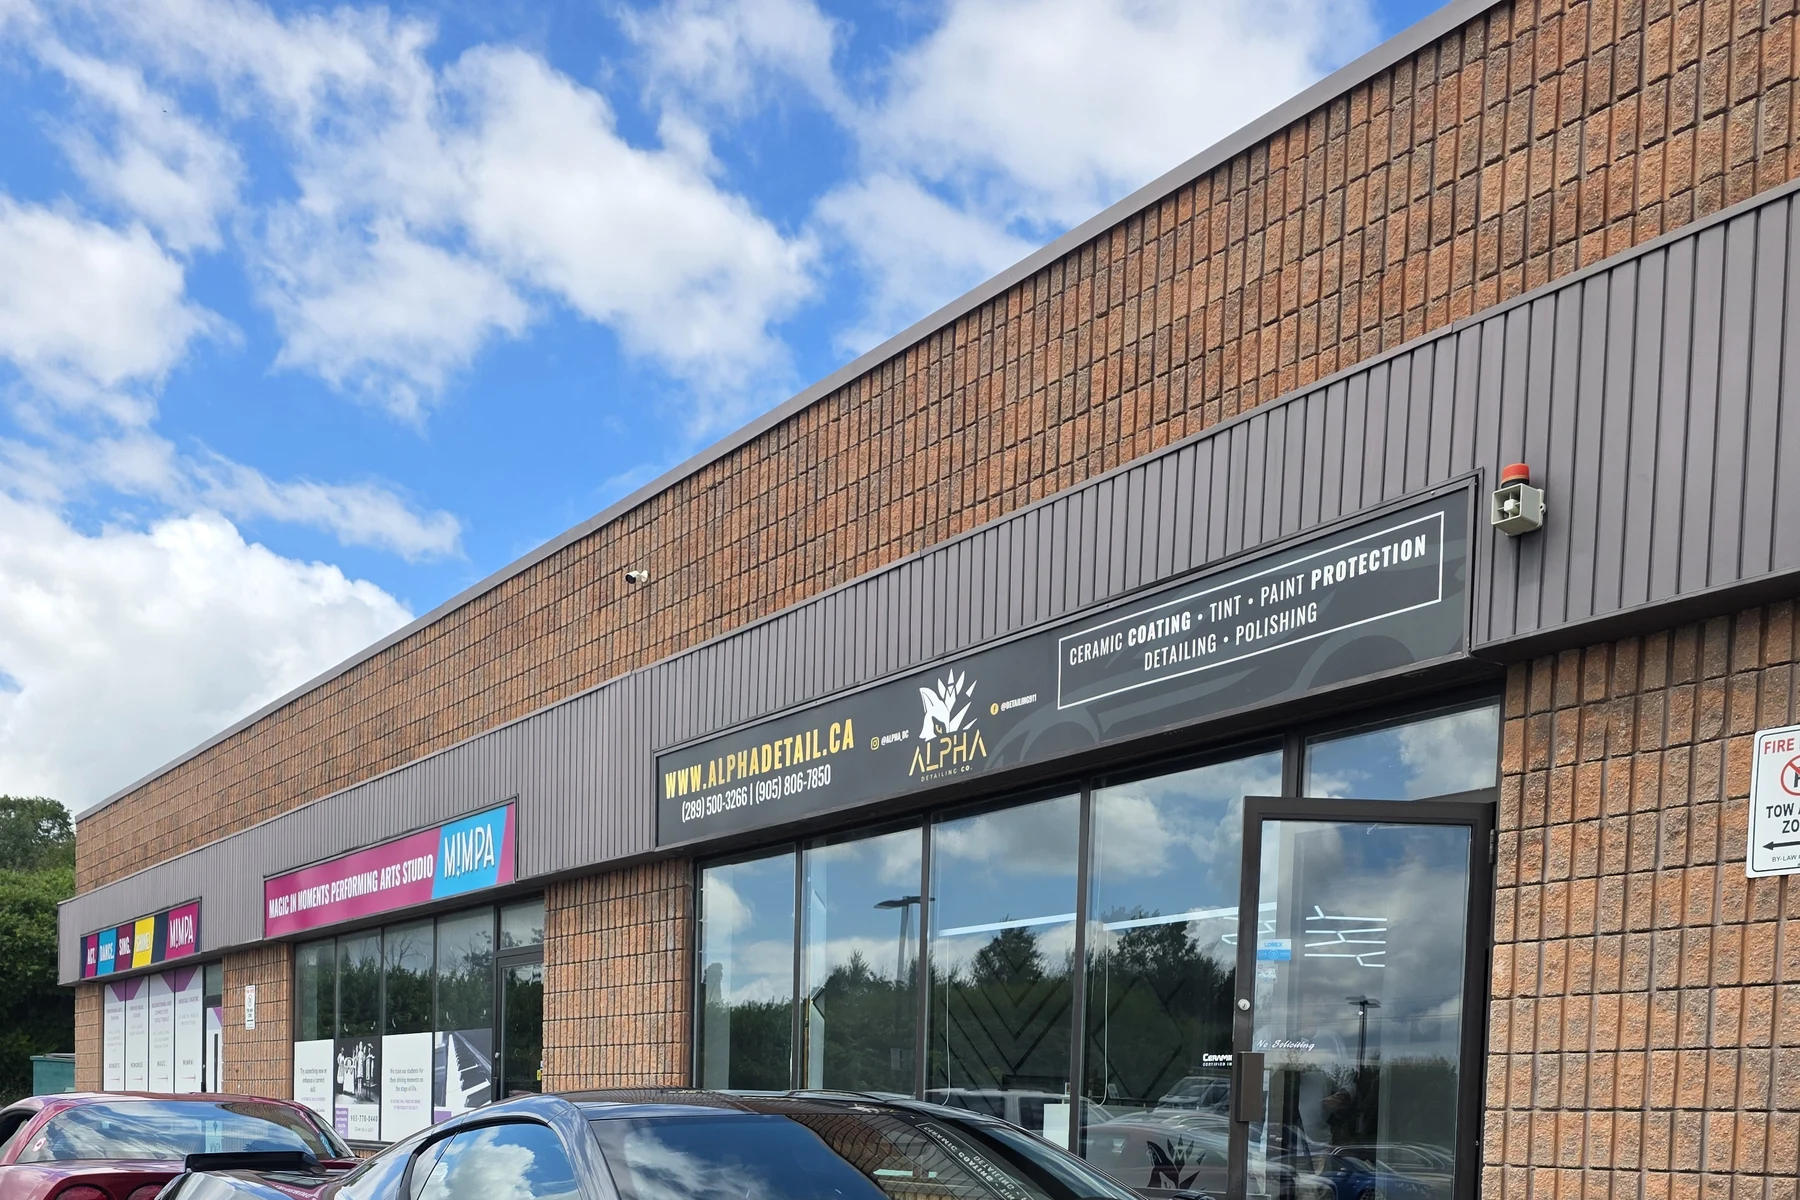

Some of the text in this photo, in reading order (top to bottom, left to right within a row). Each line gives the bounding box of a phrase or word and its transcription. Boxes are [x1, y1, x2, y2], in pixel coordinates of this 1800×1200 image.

[1069, 534, 1427, 666] CERAMIC COATING TINT PAINT PROTECTION
[1143, 602, 1318, 671] DETAILING POLISHING
[665, 718, 855, 800] WWW.ALPHADETAIL.CA
[908, 728, 987, 777] ALPHA
[1764, 737, 1795, 755] FIRE
[681, 763, 832, 823] (289) 500-3266 (905) 806-7850
[920, 764, 973, 783] DETAILING CO.
[1766, 802, 1795, 818] TOW
[1771, 854, 1798, 863] BY-LAW
[268, 853, 434, 919] MAGIC IN MOMENTS PERFORMING ARTS STUDIO
[1256, 1039, 1316, 1052] No Soliciting
